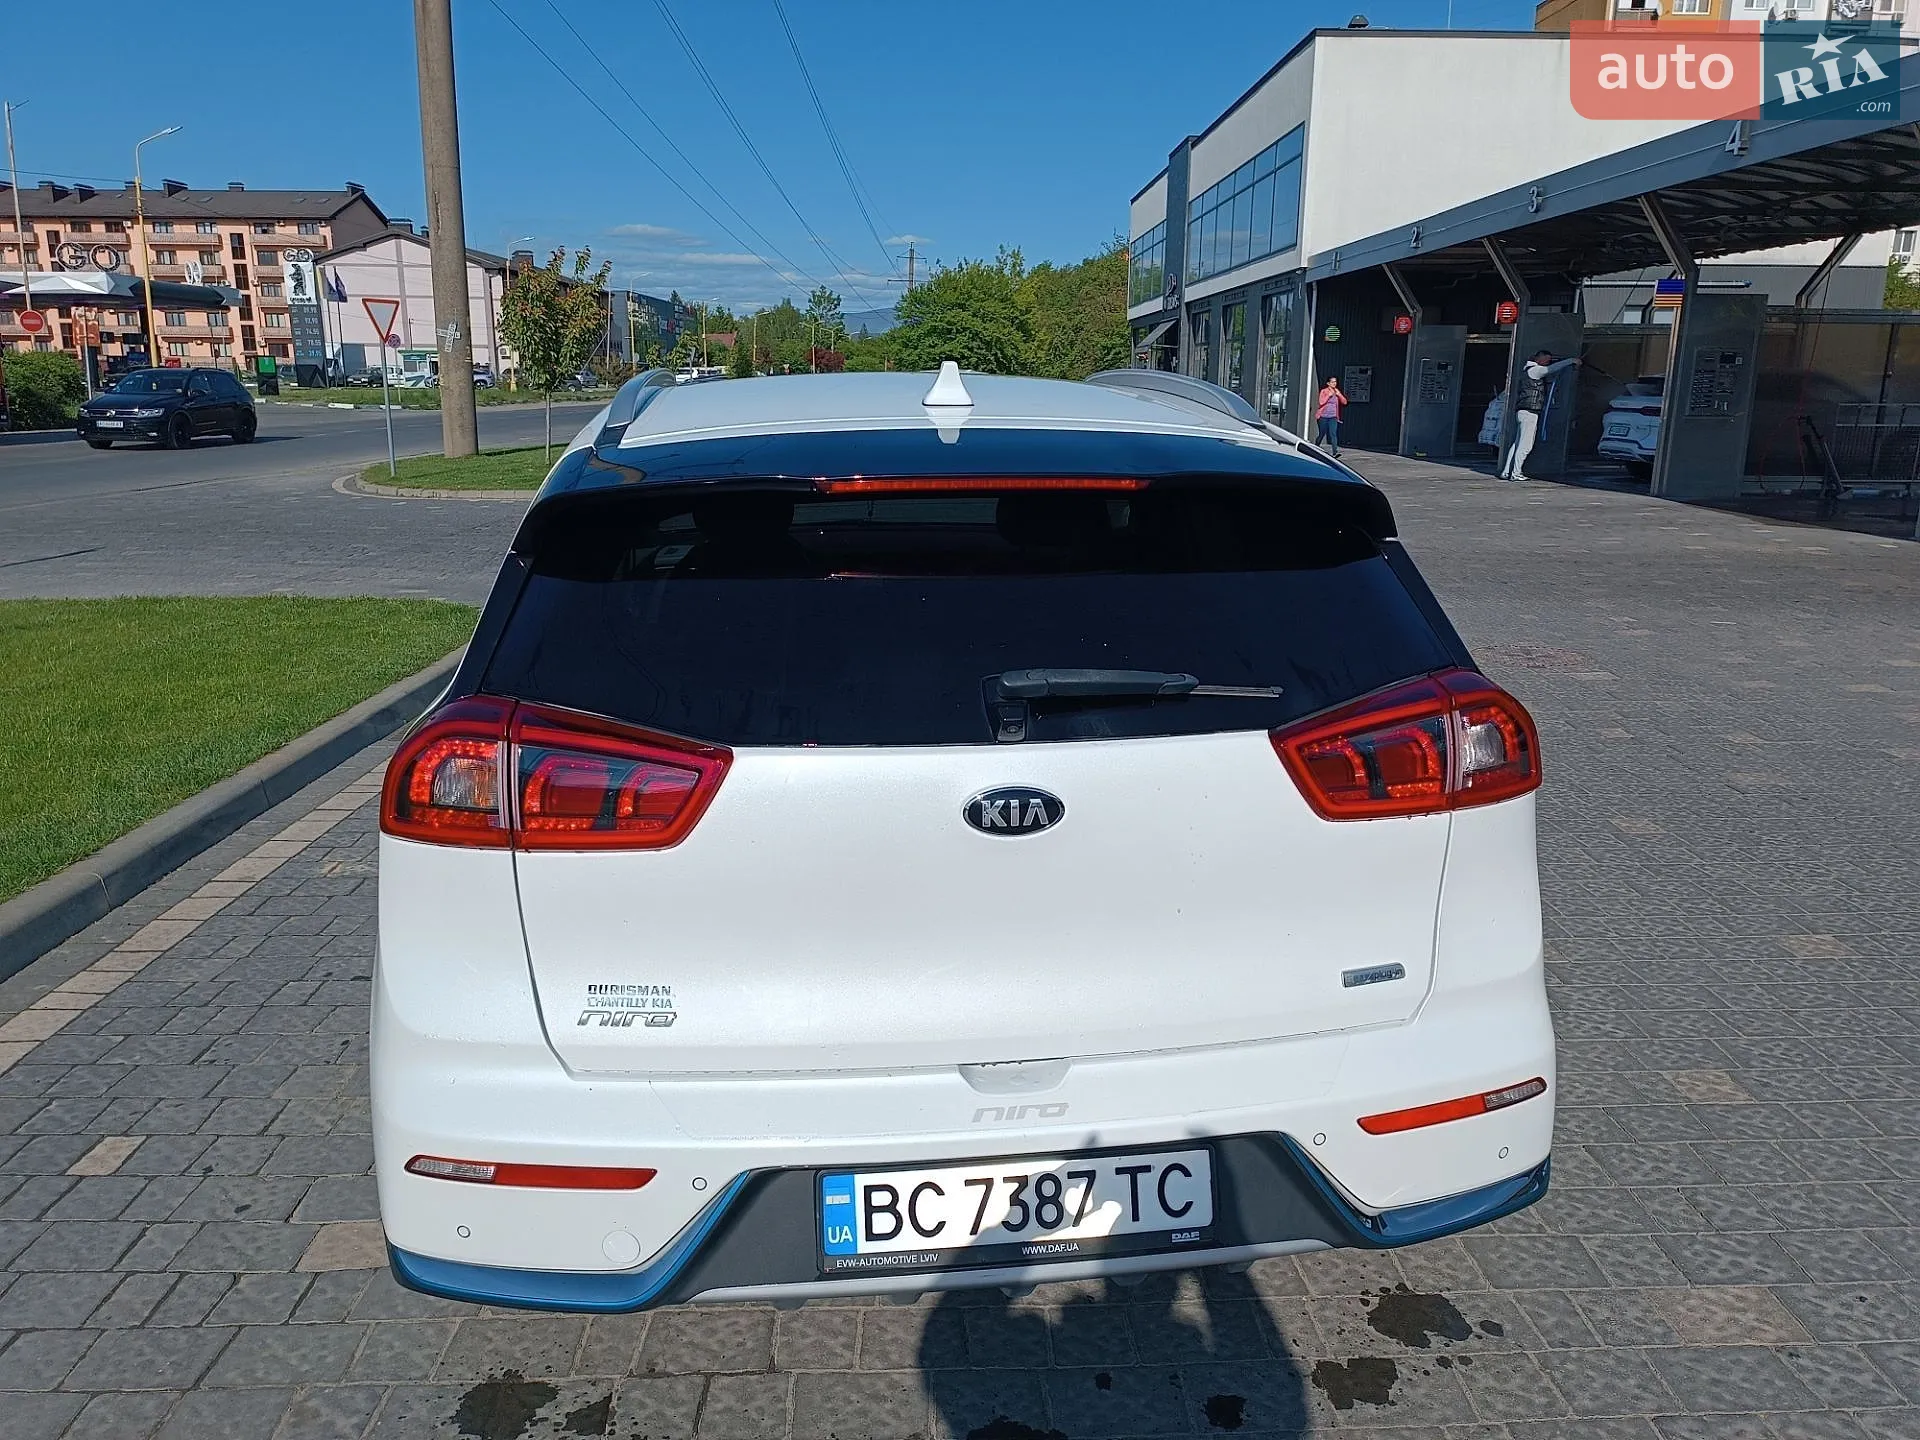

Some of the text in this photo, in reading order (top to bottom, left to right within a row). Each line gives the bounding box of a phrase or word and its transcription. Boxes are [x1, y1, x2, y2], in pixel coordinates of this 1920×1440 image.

[1724, 120, 1744, 156] 4
[1528, 186, 1541, 213] 3
[1410, 226, 1422, 248] 2
[55, 242, 121, 272] GO
[981, 798, 1049, 828] KIA
[588, 984, 671, 996] OURISMAN
[587, 996, 673, 1008] CHANTILLY KIA
[863, 1162, 1194, 1242] BC 7387 TC
[827, 1225, 854, 1244] UA
[836, 1253, 939, 1268] EVW-AUTOMOTIVE LVIV
[1021, 1243, 1079, 1256] WWW.DAF.UA
